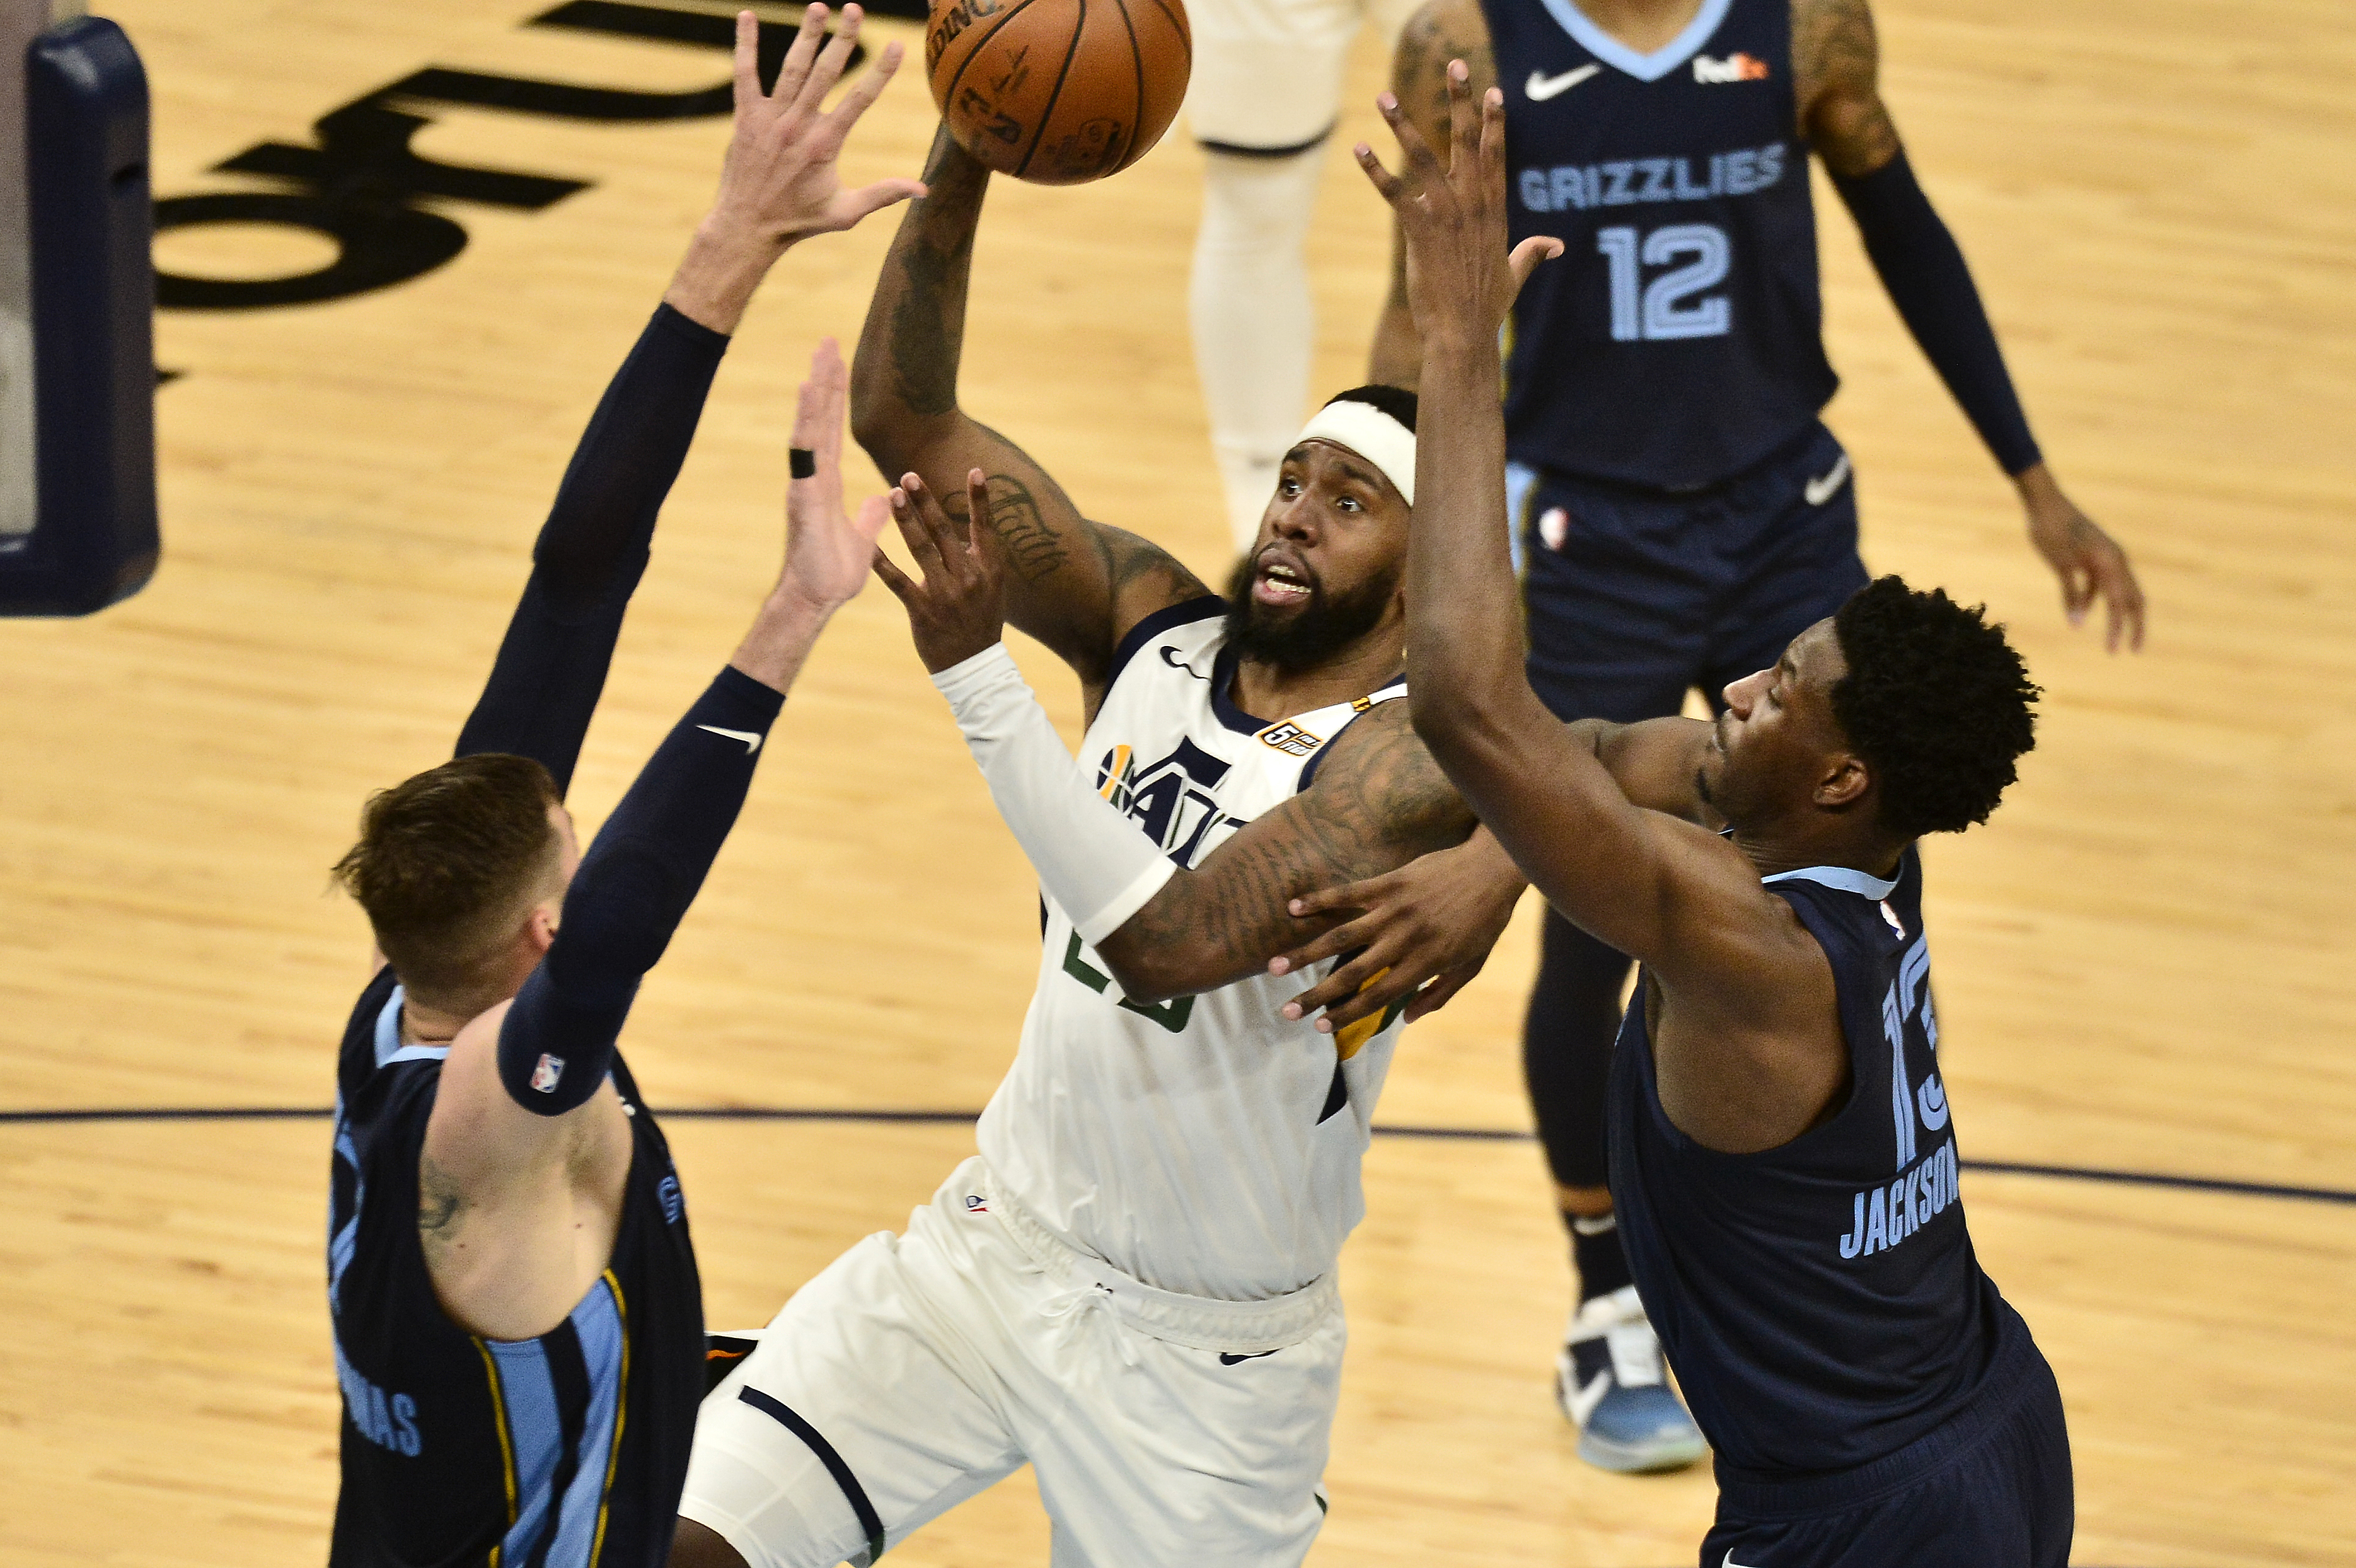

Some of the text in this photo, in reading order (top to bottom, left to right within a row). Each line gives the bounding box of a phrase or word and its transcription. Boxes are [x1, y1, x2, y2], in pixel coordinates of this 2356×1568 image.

[1519, 142, 1786, 212] GRIZZLIES
[1597, 224, 1733, 341] 12
[1264, 725, 1300, 745] 5
[1839, 1136, 1960, 1259] JACKSON
